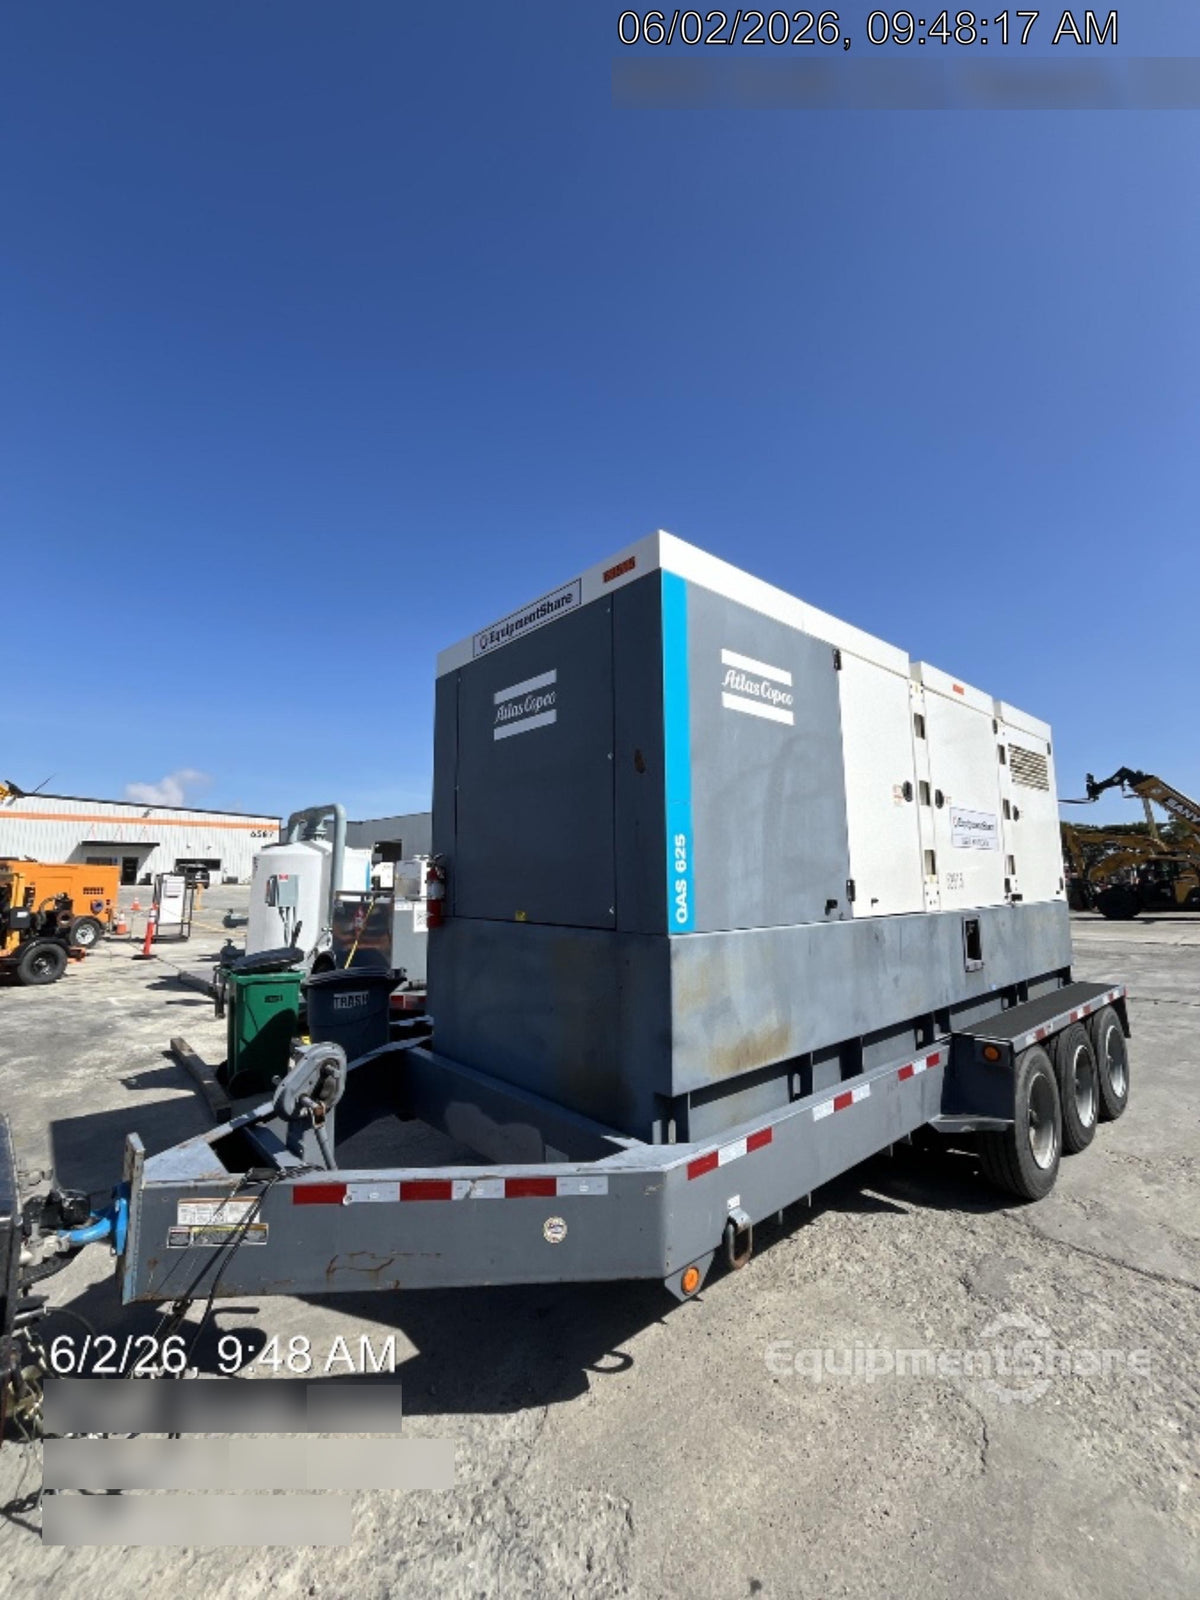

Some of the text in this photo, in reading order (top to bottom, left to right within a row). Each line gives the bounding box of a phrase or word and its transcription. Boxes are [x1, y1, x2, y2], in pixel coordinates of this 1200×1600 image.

[488, 592, 574, 644] EquipmentShare
[721, 669, 794, 705] Atlas Copco
[674, 833, 687, 873] 625
